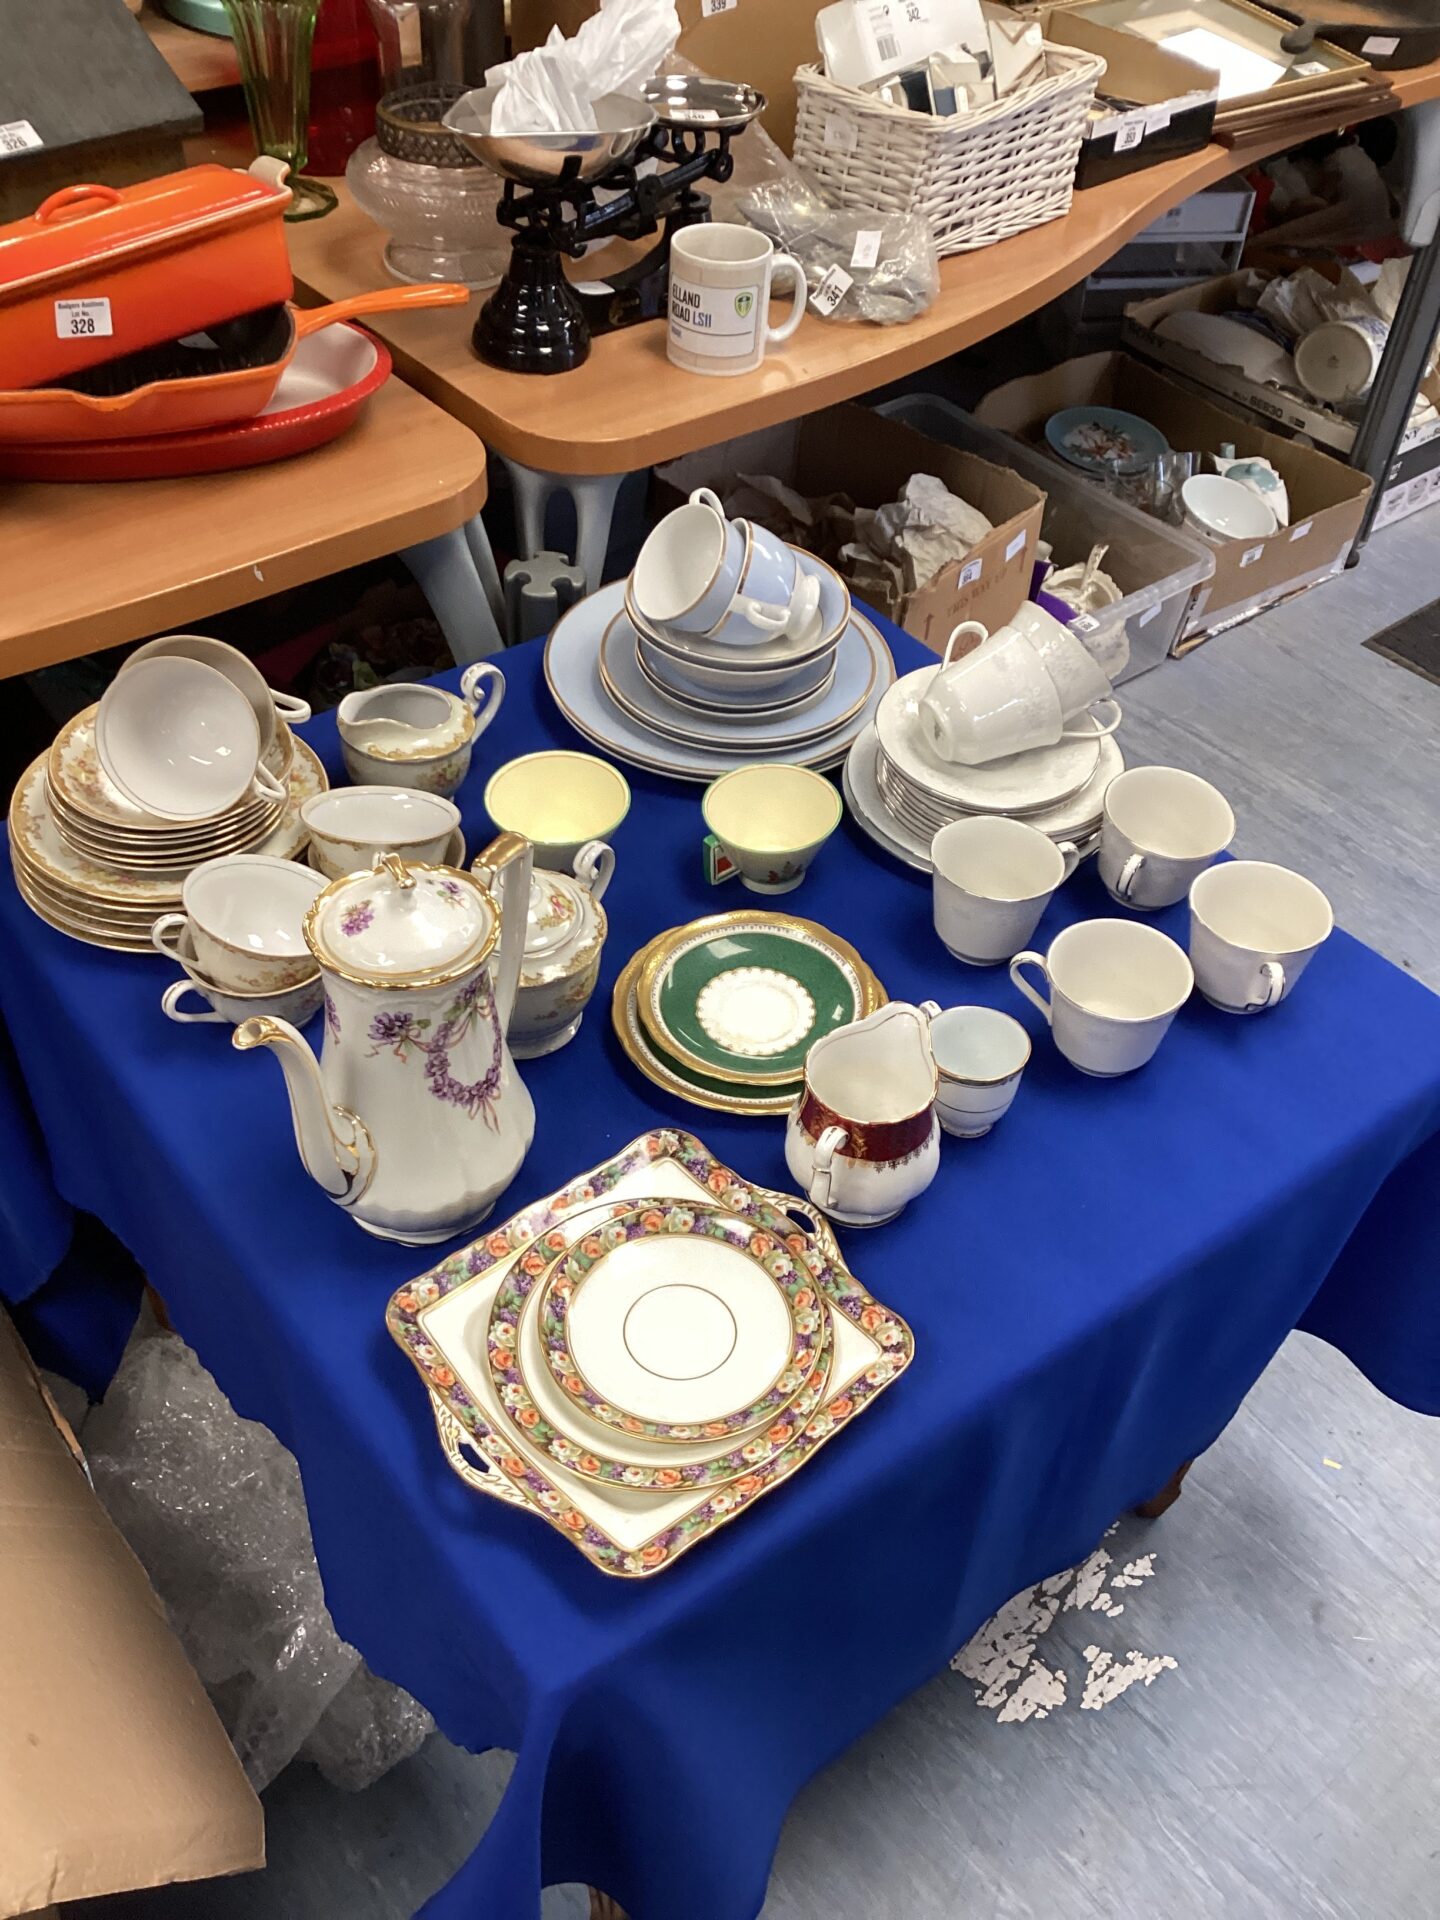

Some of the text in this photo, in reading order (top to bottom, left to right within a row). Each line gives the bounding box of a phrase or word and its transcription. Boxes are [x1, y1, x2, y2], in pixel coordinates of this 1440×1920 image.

[907, 7, 920, 22] 342
[673, 283, 701, 309] ELLAND
[827, 285, 844, 307] 341
[672, 300, 690, 322] ROAD
[71, 318, 95, 335] 328
